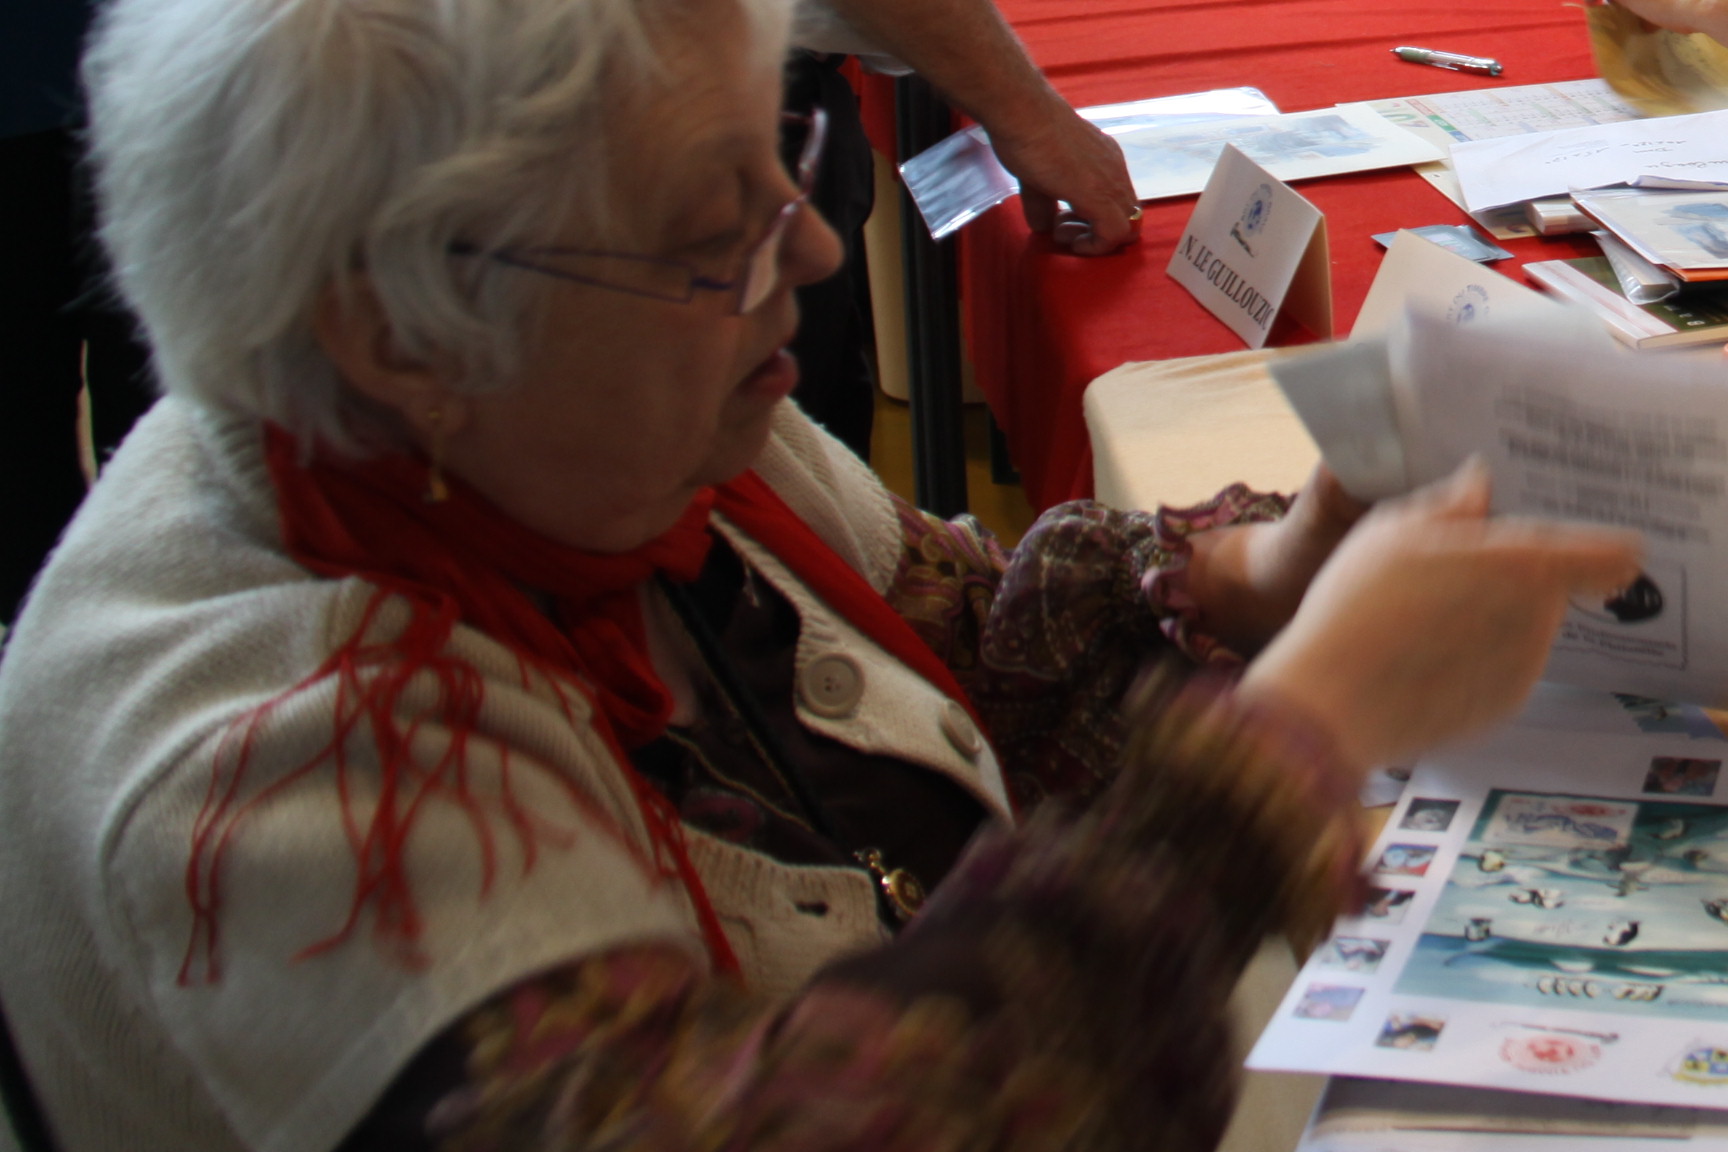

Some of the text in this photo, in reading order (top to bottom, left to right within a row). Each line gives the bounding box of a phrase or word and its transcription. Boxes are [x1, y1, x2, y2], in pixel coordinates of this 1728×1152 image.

[1178, 234, 1198, 260] N.
[1192, 245, 1213, 273] LE
[1207, 258, 1275, 331] GUILLOUZIC
